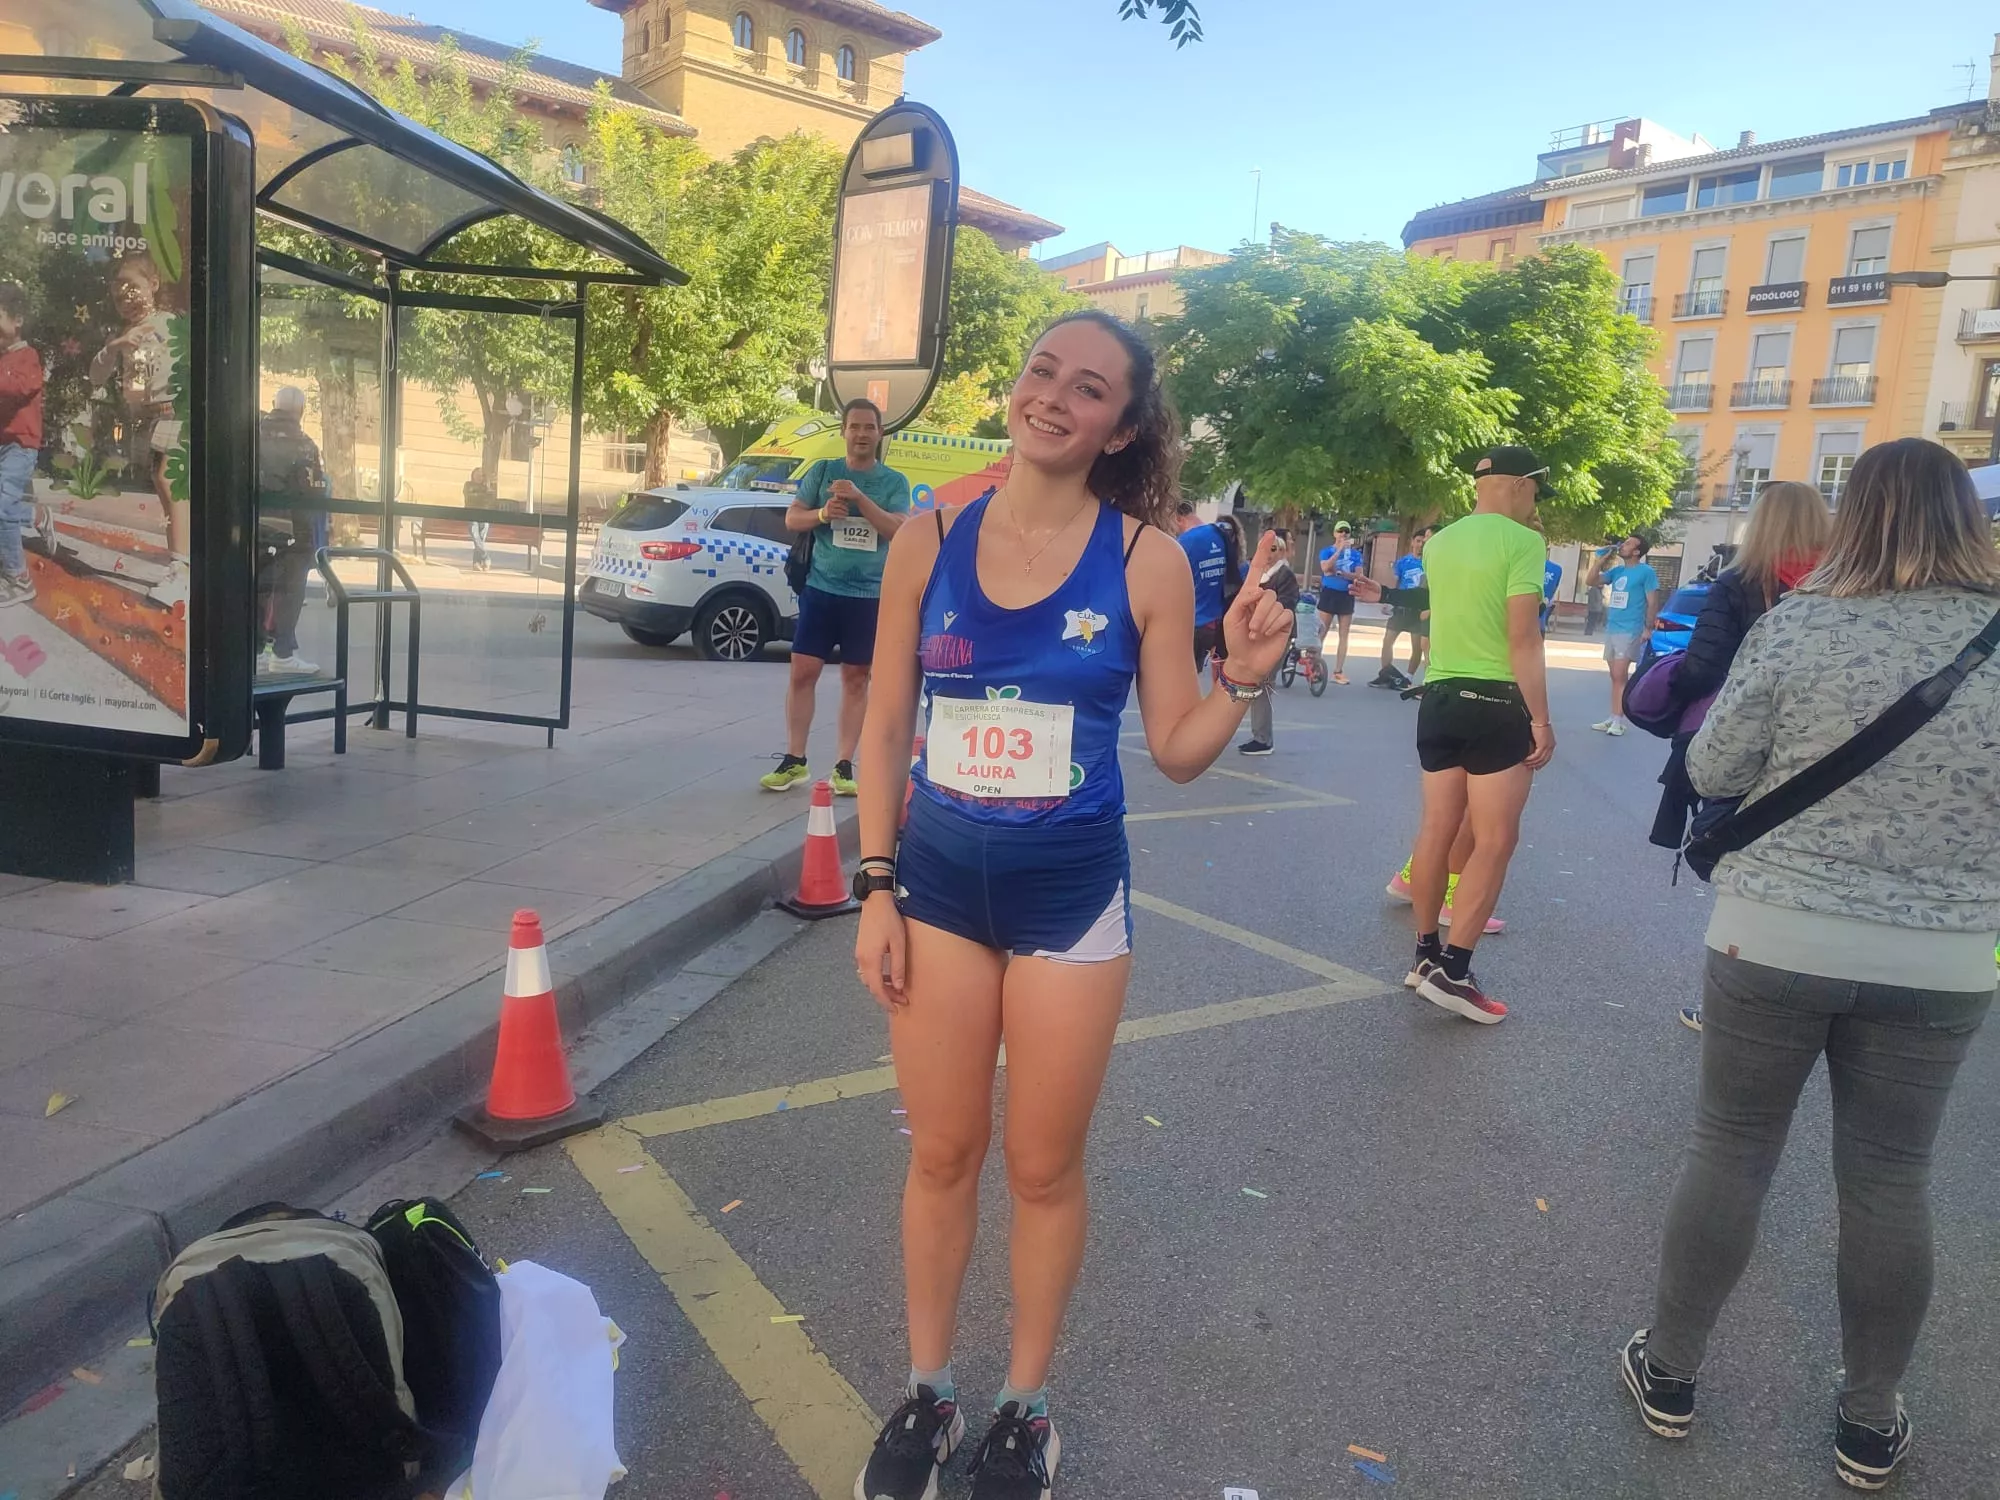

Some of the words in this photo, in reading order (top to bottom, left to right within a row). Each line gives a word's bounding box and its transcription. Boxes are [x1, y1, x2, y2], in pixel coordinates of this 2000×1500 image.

[846, 224, 872, 241] CON
[876, 218, 924, 238] TIEMPO
[37, 229, 78, 246] hace
[81, 233, 148, 251] amigos
[1831, 285, 1846, 295] 611
[1848, 284, 1859, 293] 59
[843, 527, 870, 538] 1022
[40, 688, 47, 699] El
[49, 689, 70, 701] Corte
[71, 693, 96, 706] Inglés
[104, 697, 157, 711] mayoral.com
[954, 705, 989, 713] CARRERA
[990, 705, 1001, 713] DE
[1001, 706, 1046, 718] EMPRESAS
[973, 713, 1001, 721] HUESCA
[962, 725, 1034, 761] 103
[956, 762, 1017, 780] LAURA
[973, 784, 1002, 794] OPEN
